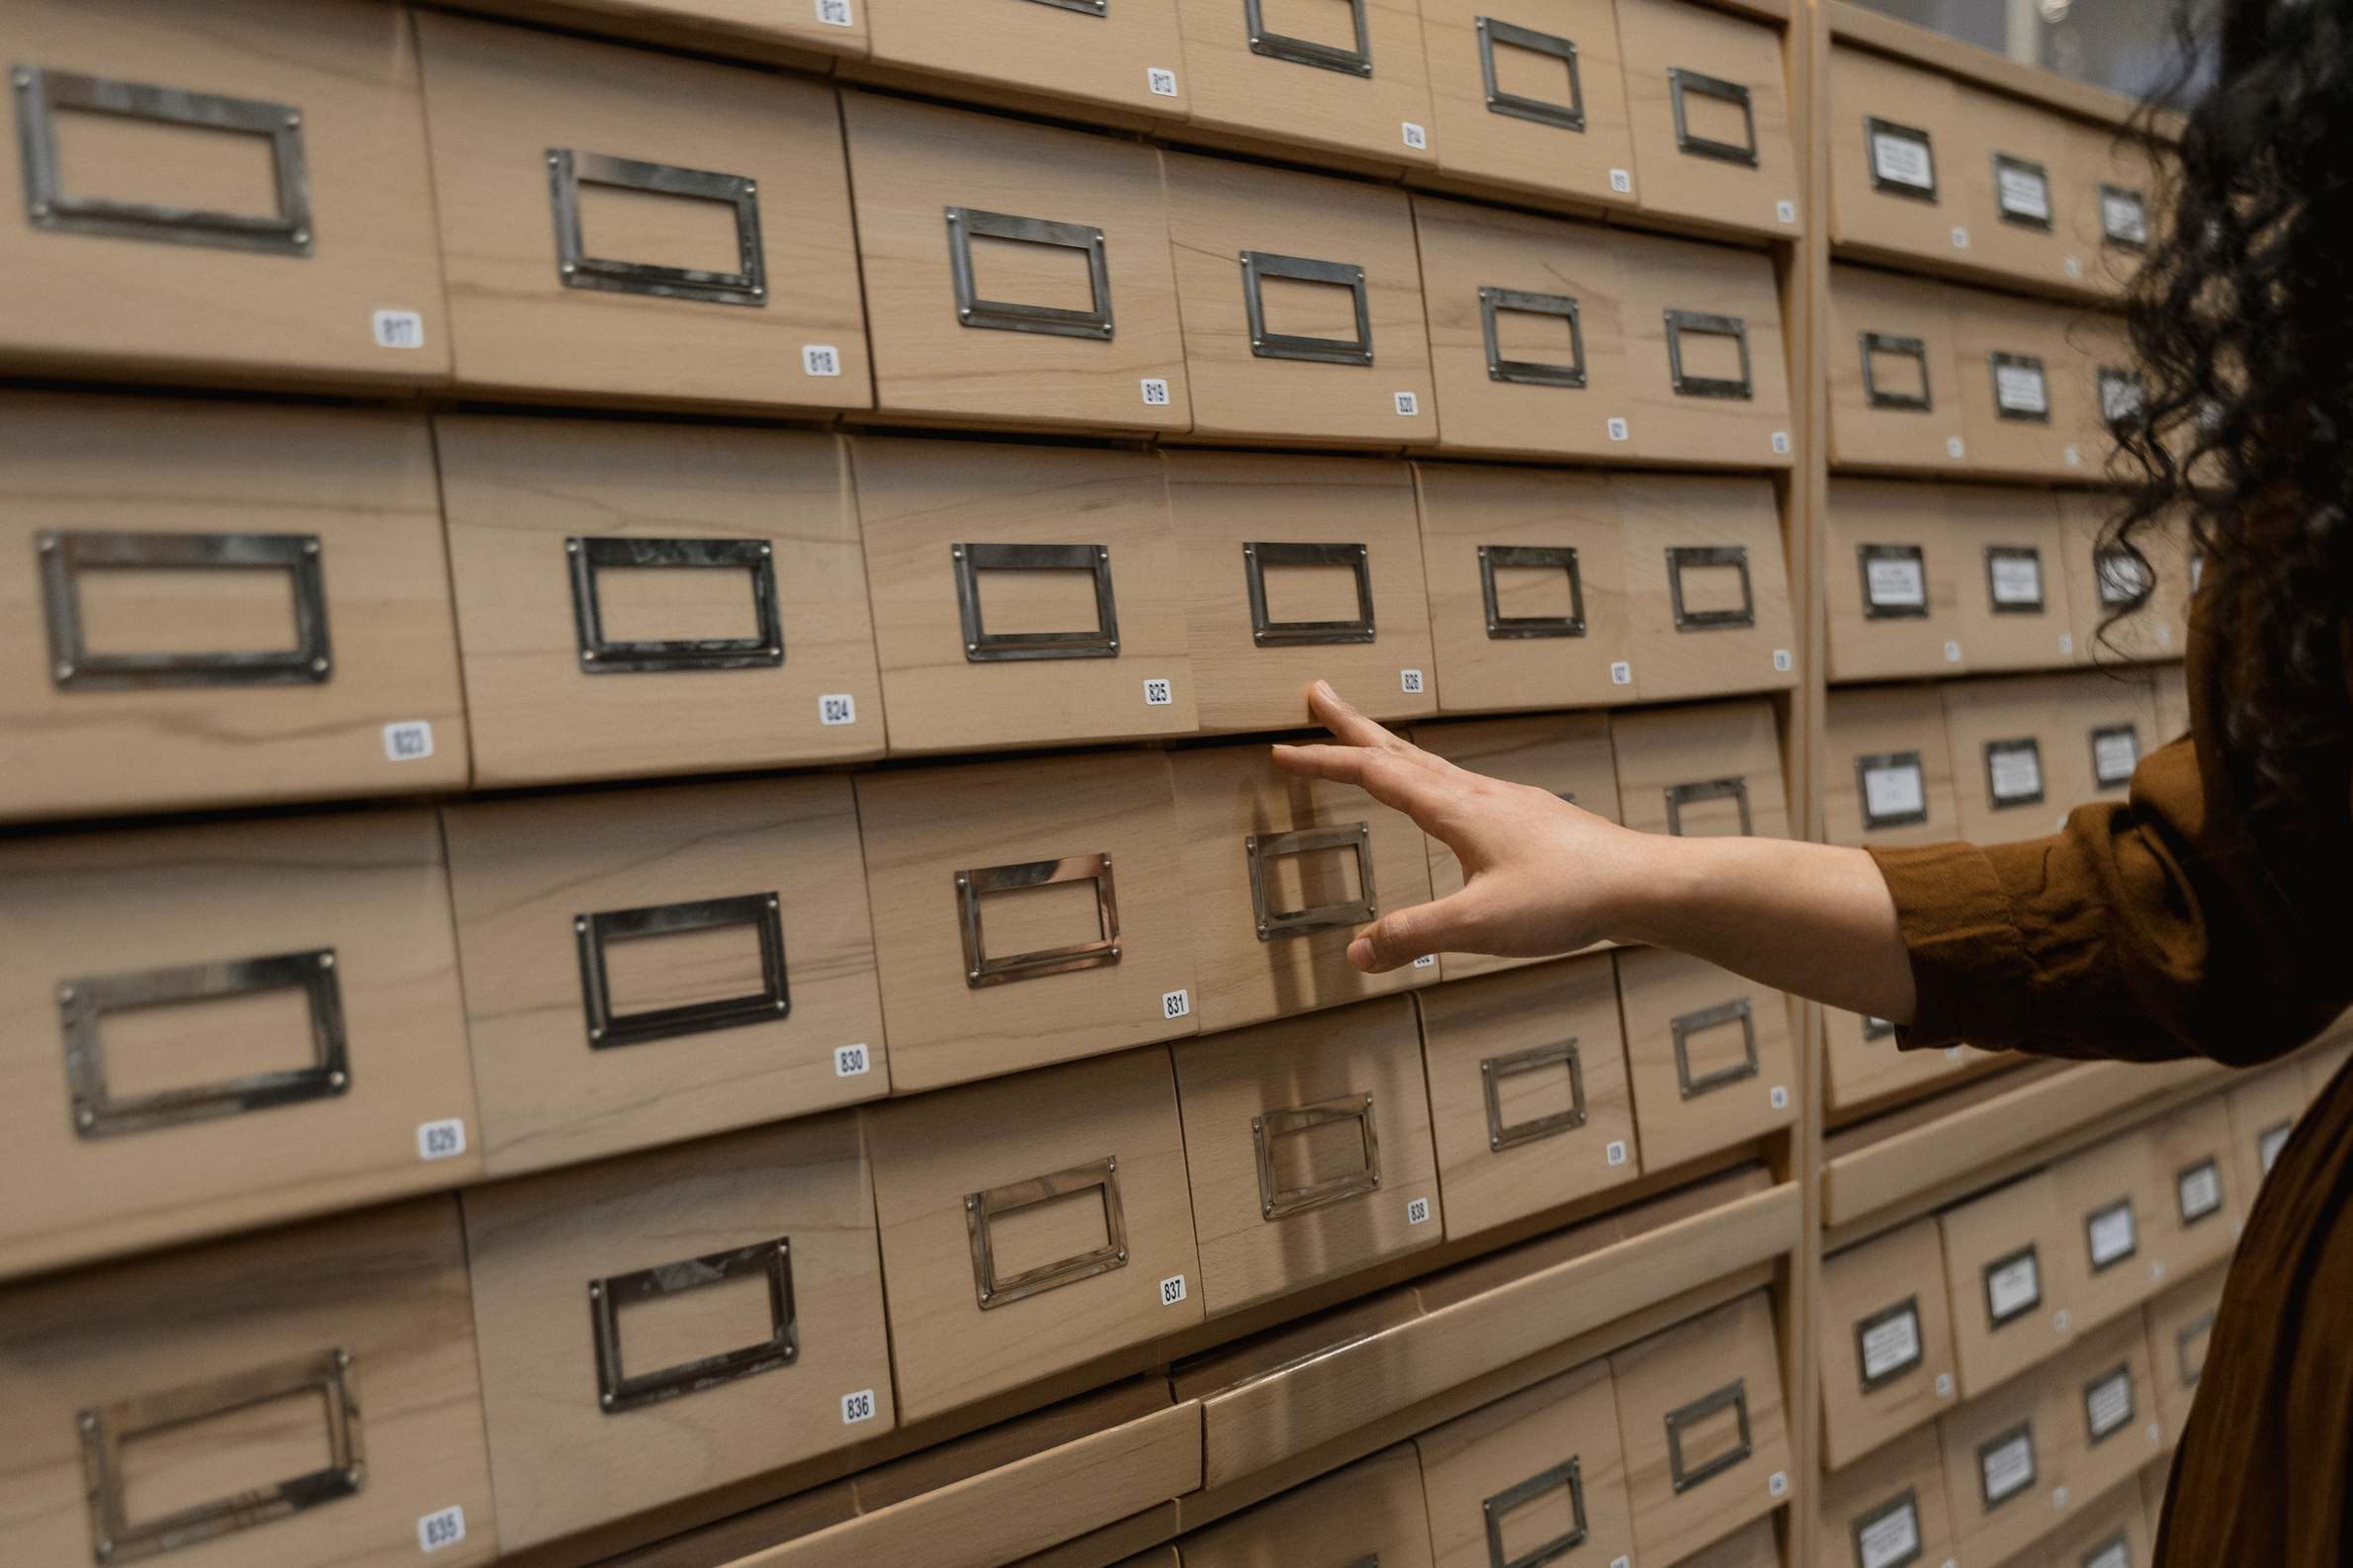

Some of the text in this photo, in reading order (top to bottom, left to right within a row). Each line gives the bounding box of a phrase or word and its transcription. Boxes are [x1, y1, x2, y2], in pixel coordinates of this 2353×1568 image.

[809, 350, 833, 373] 818
[1148, 682, 1168, 702] 825
[1404, 672, 1420, 690] 826
[825, 699, 848, 721] 824
[1168, 994, 1185, 1015] 831
[840, 1049, 863, 1073] 830
[1410, 1202, 1425, 1221] 838
[1165, 1277, 1180, 1302] 837
[846, 1394, 870, 1421] 836
[426, 1514, 457, 1545] 835
